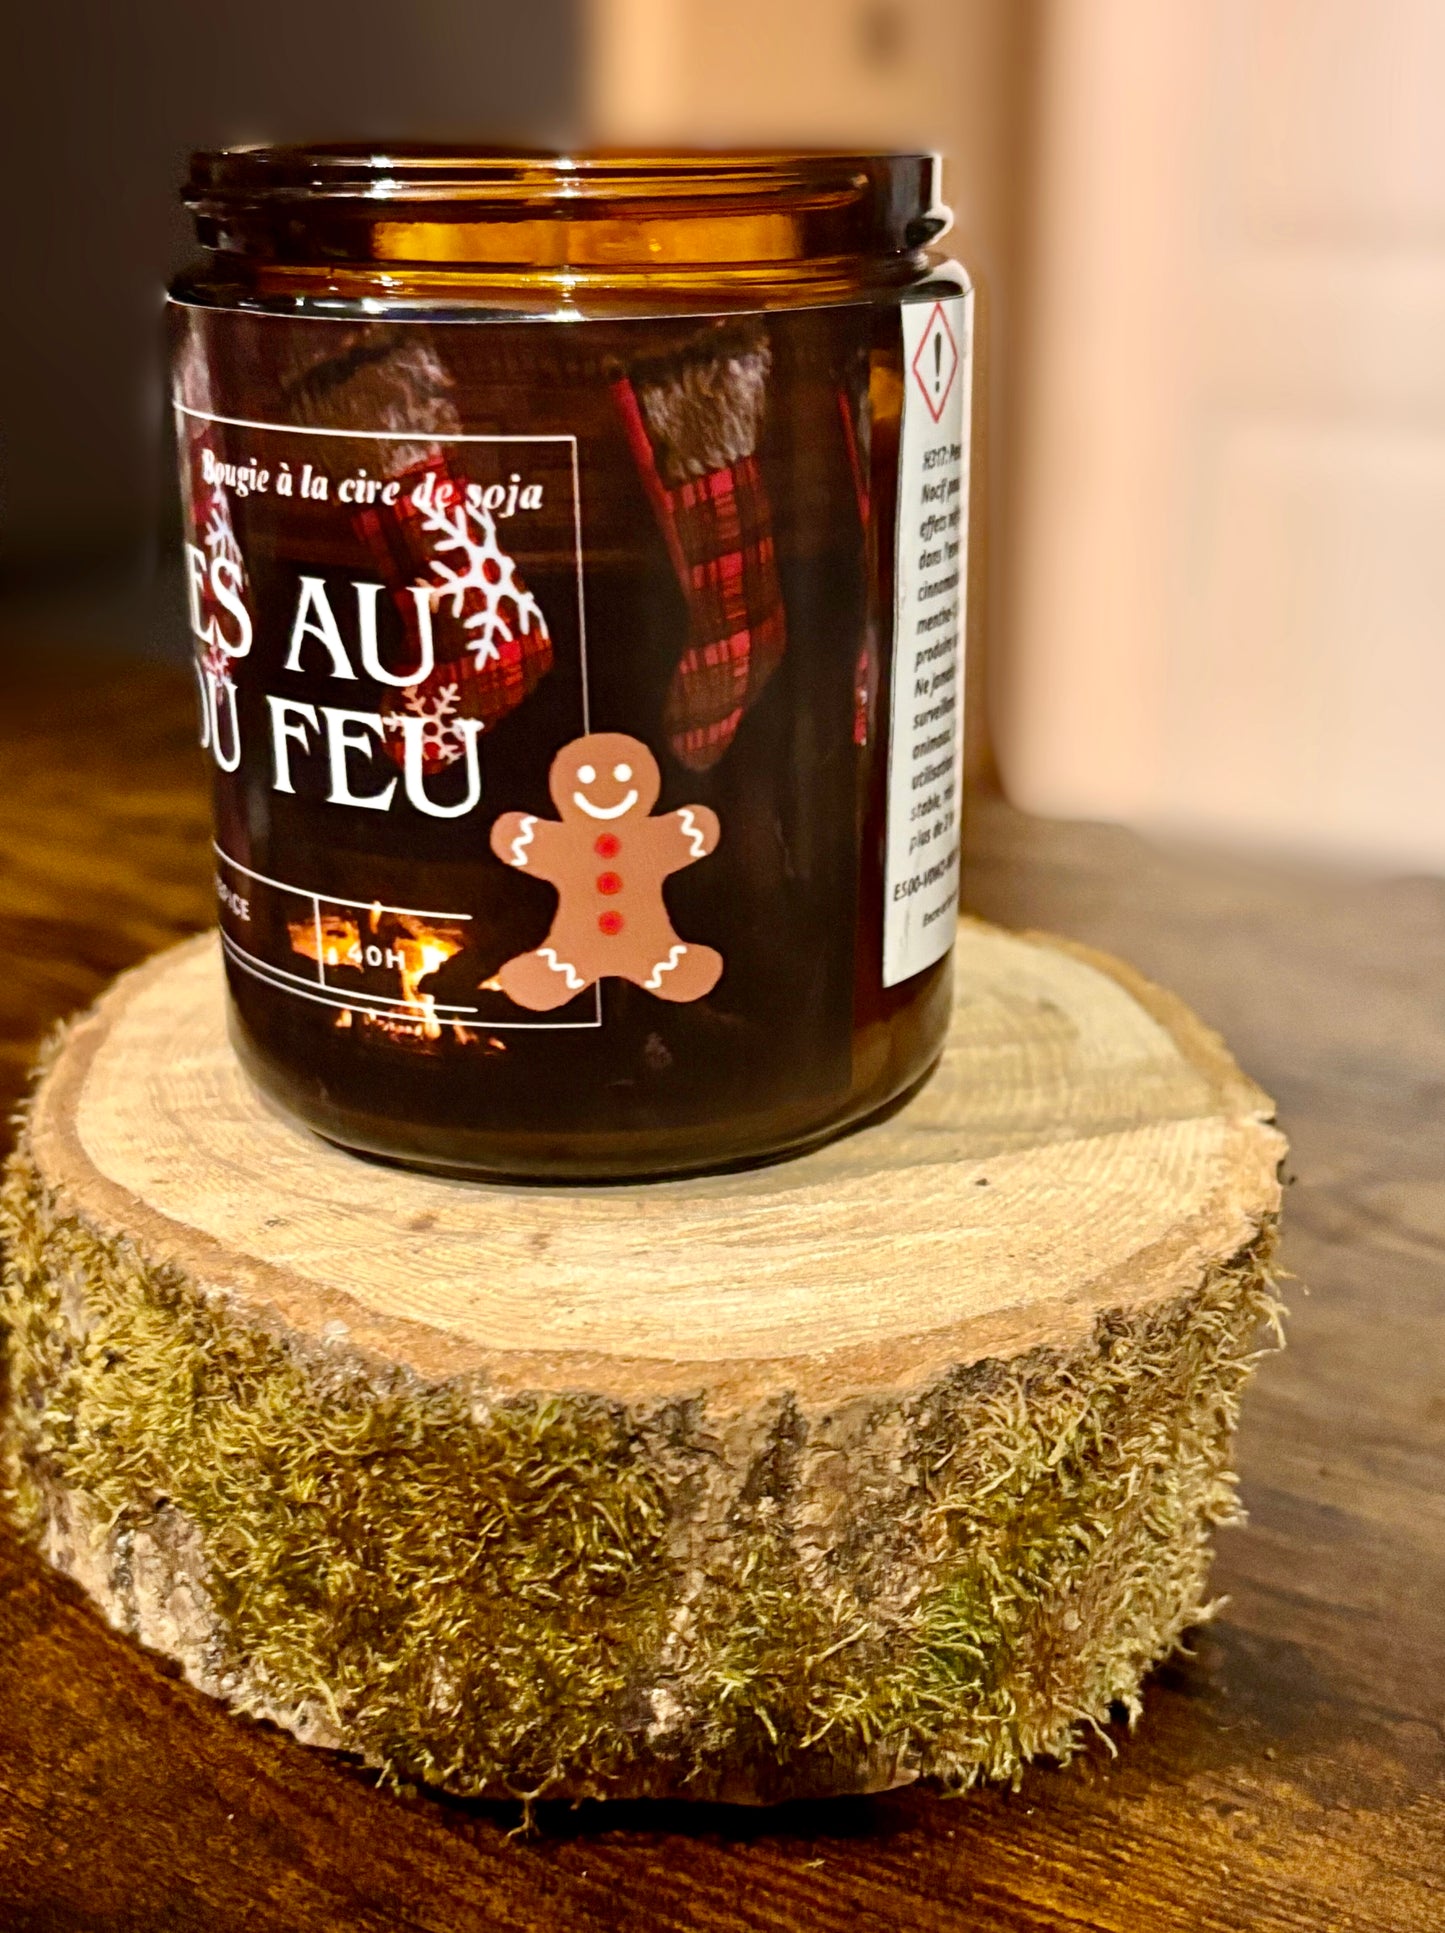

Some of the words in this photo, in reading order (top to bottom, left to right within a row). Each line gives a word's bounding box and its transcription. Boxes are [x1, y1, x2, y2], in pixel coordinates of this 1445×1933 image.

[201, 448, 269, 497] Bougie
[276, 462, 293, 497] à
[301, 465, 329, 501] la
[338, 469, 401, 506] cire
[412, 472, 454, 510] de
[465, 474, 544, 519] soja
[284, 576, 436, 686] AU
[266, 695, 484, 818] FEU
